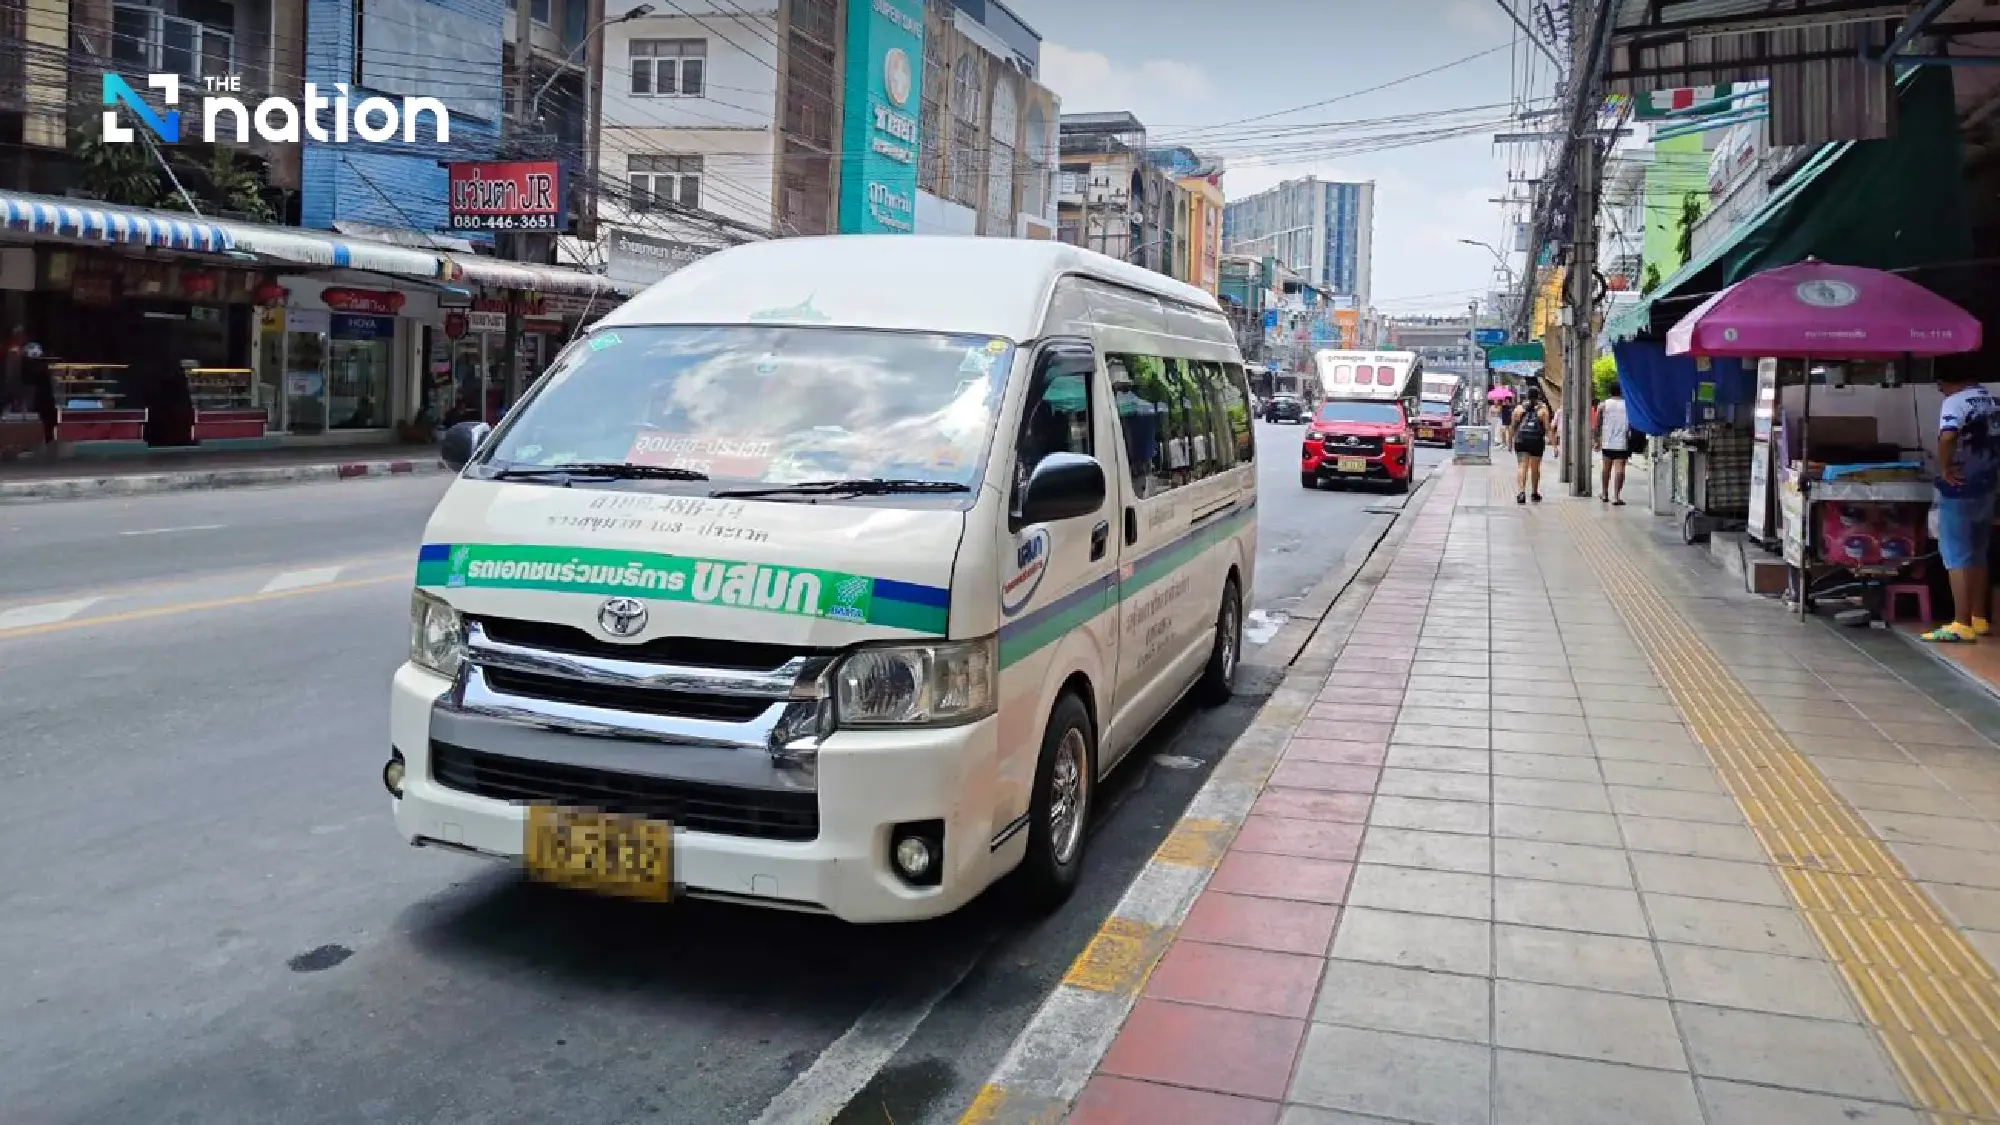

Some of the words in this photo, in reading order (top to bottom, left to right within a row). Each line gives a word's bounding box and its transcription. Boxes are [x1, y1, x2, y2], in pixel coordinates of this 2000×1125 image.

[453, 167, 518, 211] แว่นตา
[519, 173, 555, 212] JR
[453, 214, 556, 229] 080-446-3651
[467, 557, 686, 592] รถเอกชนร่วมบริการ
[690, 560, 824, 616] ขสมก.
